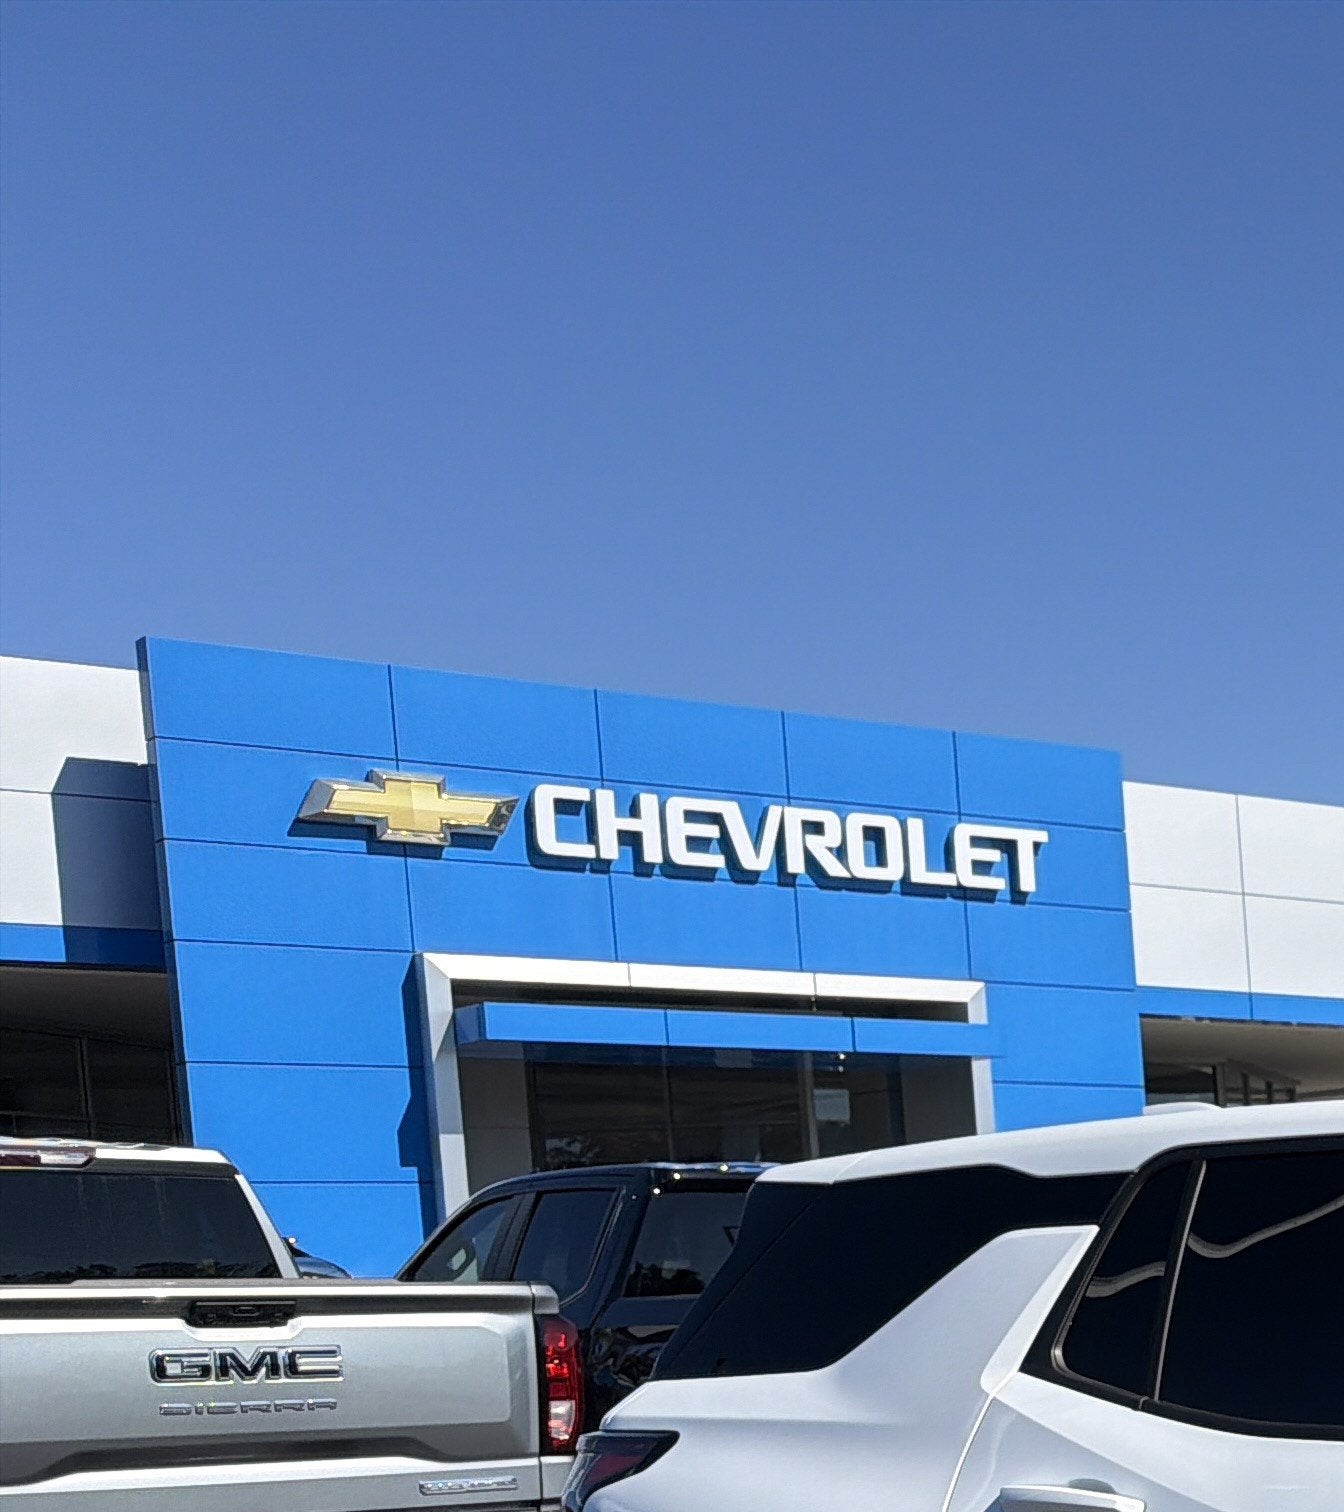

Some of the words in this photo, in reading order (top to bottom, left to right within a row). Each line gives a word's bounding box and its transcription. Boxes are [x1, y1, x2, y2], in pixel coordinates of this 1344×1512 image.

[533, 783, 1049, 893] CHEVROLET
[149, 1344, 344, 1387] GMC
[159, 1397, 338, 1416] SIERRA
